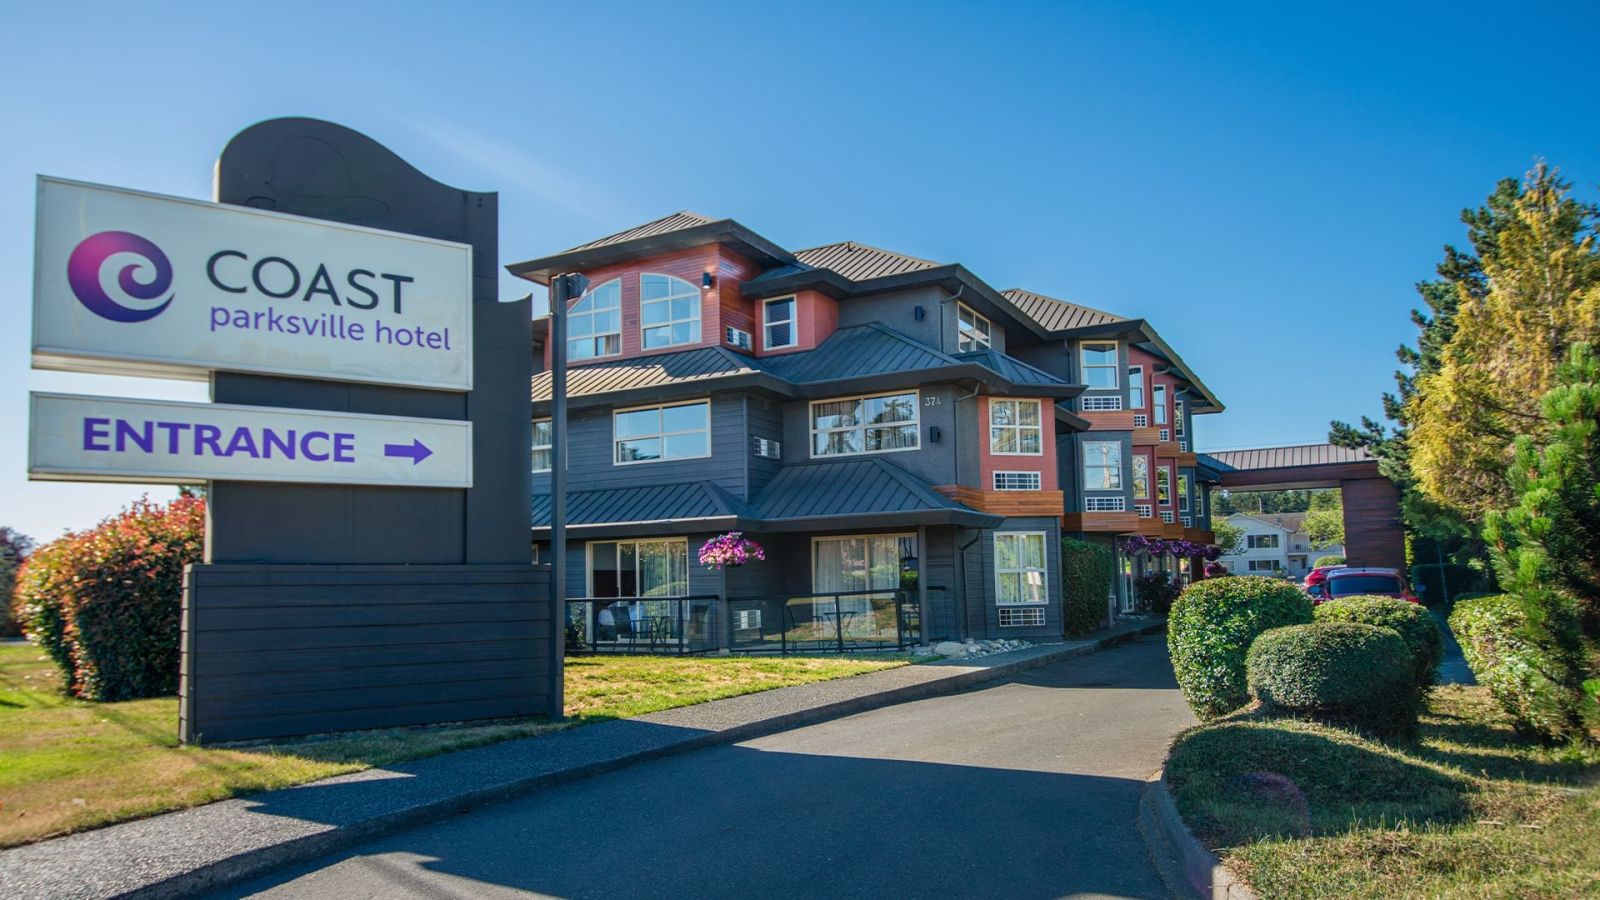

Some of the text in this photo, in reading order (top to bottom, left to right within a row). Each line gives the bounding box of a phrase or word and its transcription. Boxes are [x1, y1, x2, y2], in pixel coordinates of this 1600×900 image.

[206, 249, 414, 314] COAST
[210, 304, 451, 350] parksville hotel
[924, 396, 941, 407] 374
[83, 417, 356, 463] ENTRANCE
